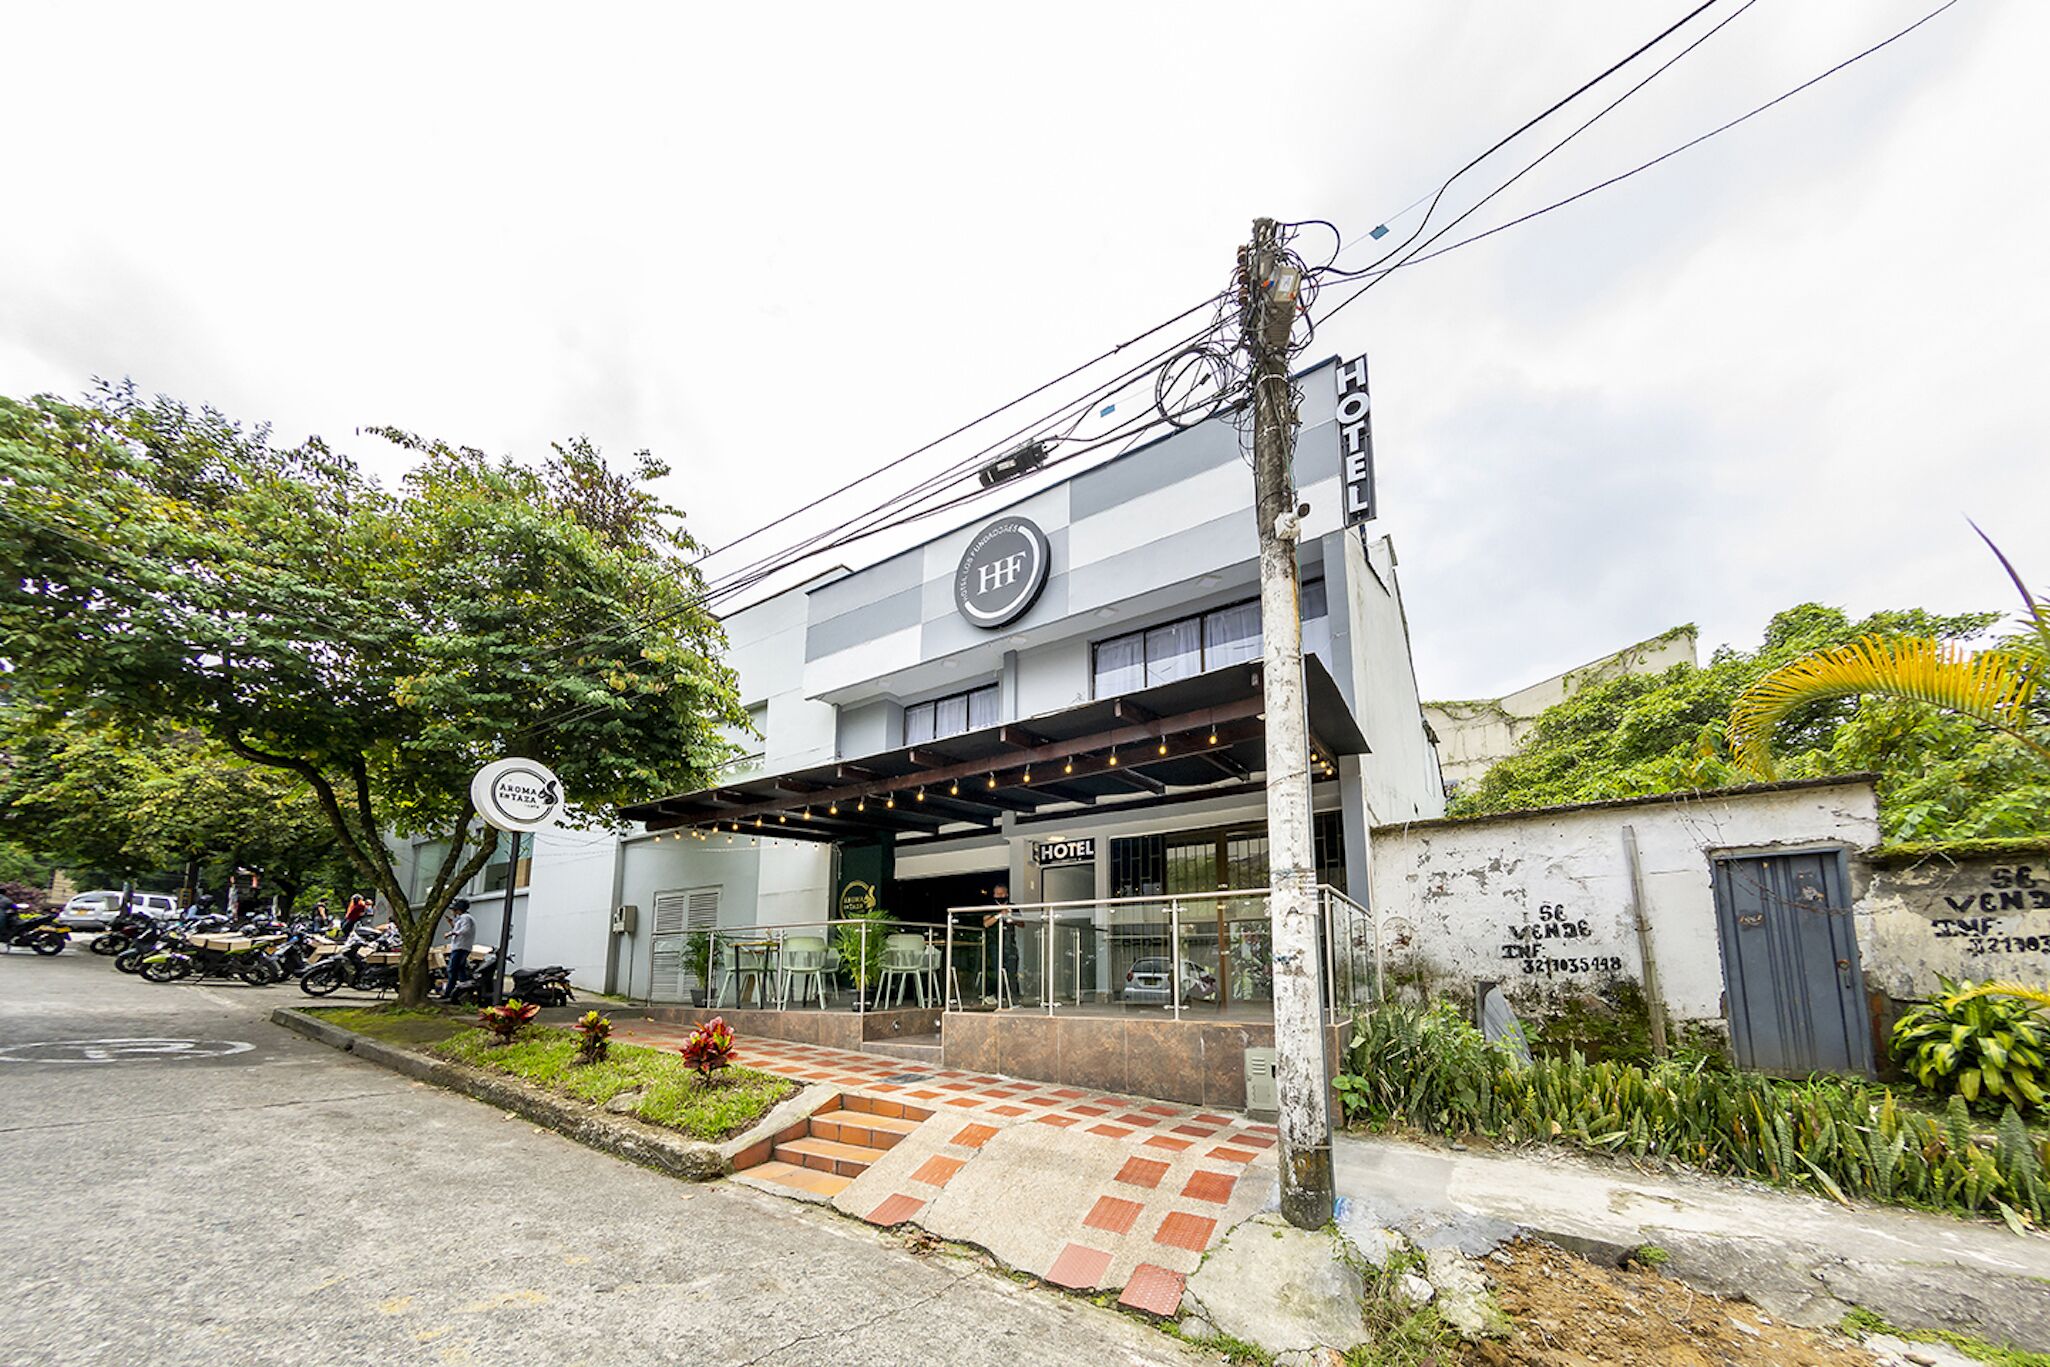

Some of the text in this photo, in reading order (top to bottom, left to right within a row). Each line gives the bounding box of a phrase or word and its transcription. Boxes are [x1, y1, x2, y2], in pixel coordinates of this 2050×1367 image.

[1336, 357, 1370, 514] HOTEL
[976, 551, 1027, 596] HF
[500, 783, 537, 795] AROMA
[511, 794, 536, 804] TAZA
[1041, 841, 1095, 860] HOTEL
[1990, 866, 2037, 889] SE
[1539, 904, 1567, 922] SE
[1508, 919, 1592, 940] VENDE
